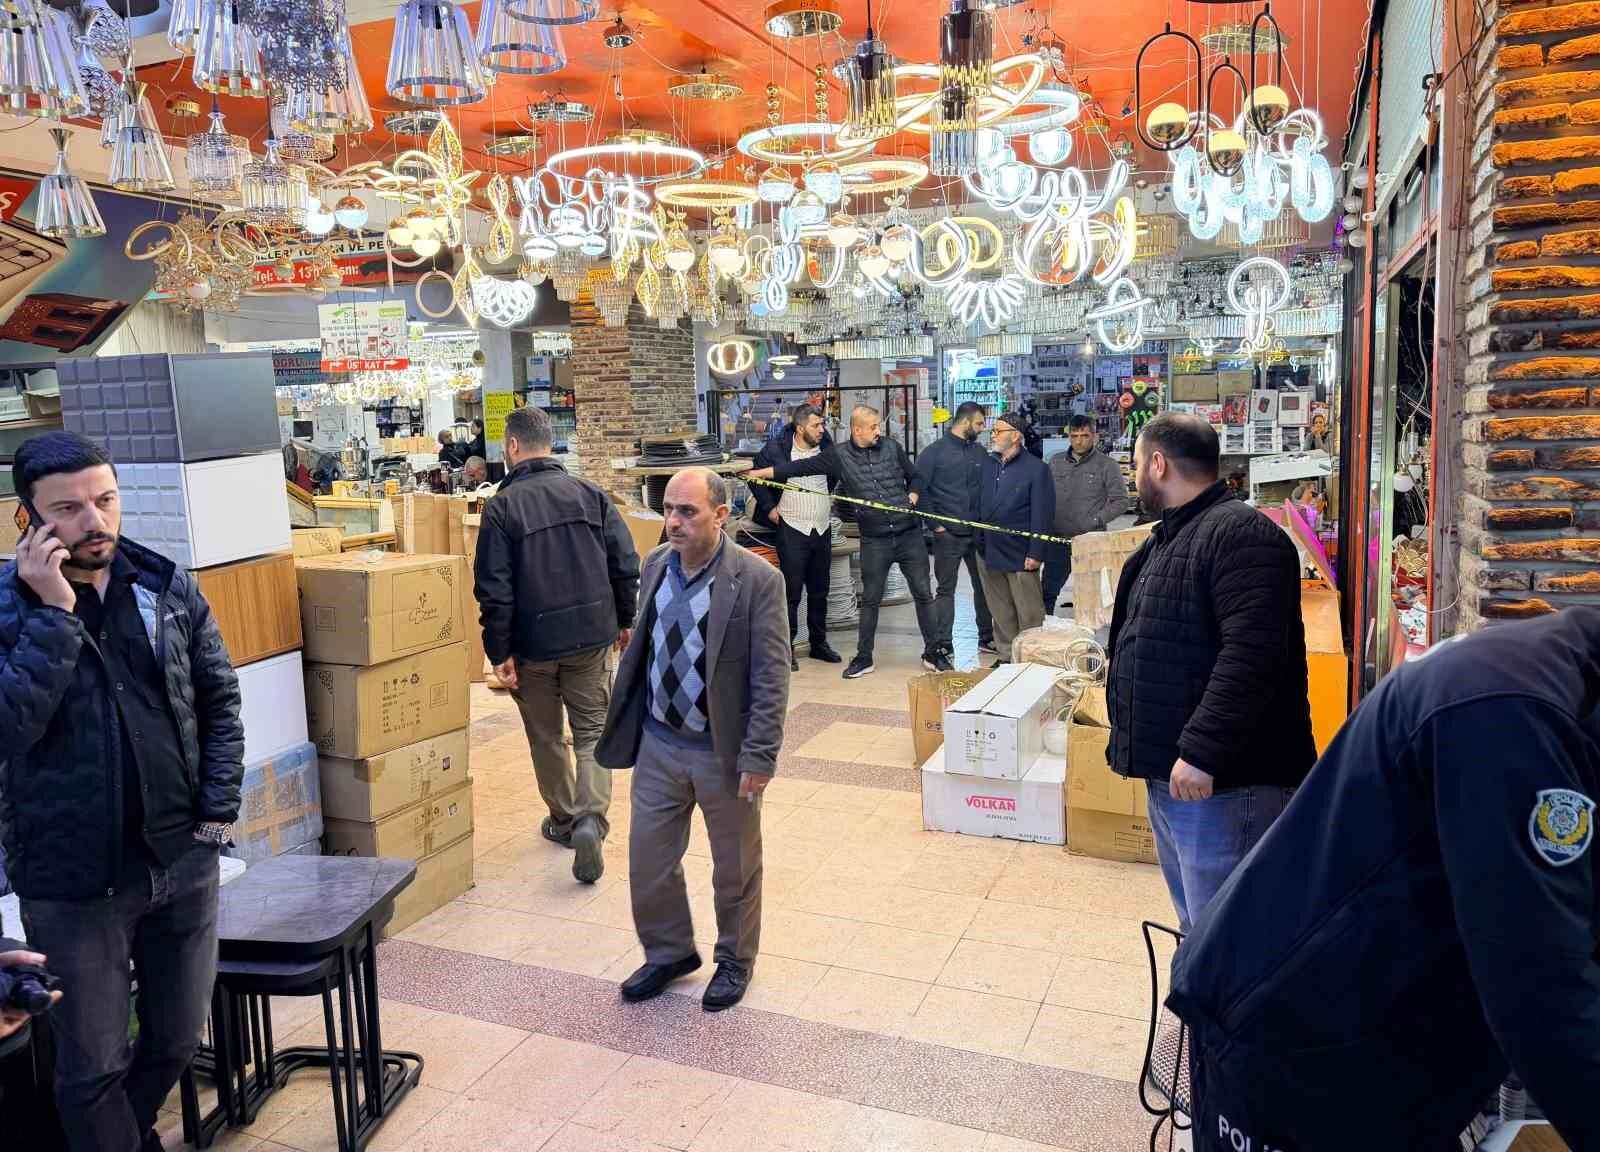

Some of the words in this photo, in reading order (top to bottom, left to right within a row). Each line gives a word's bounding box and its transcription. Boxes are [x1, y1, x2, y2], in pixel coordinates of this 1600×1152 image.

[350, 241, 365, 252] VE
[364, 360, 381, 369] KAT
[965, 795, 1017, 812] VOLKAN
